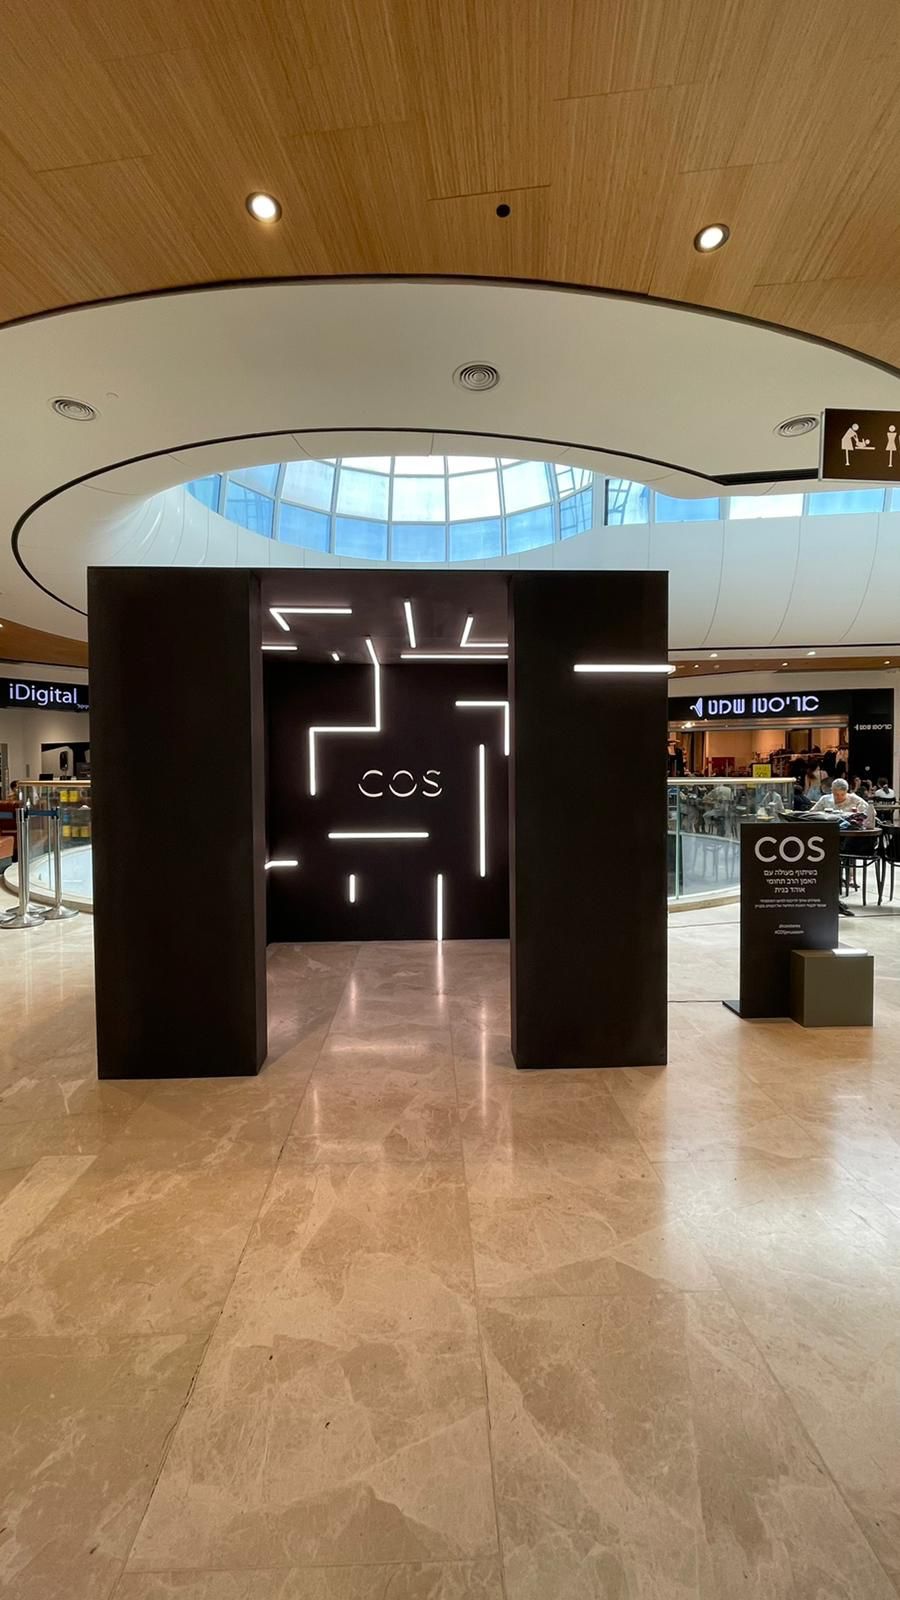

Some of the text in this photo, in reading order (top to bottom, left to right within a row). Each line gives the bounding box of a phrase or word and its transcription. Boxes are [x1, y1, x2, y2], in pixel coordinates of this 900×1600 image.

[9, 683, 77, 706] iDigital
[357, 769, 443, 798] COS
[754, 835, 826, 863] COS
[794, 869, 818, 877] בשיתוף
